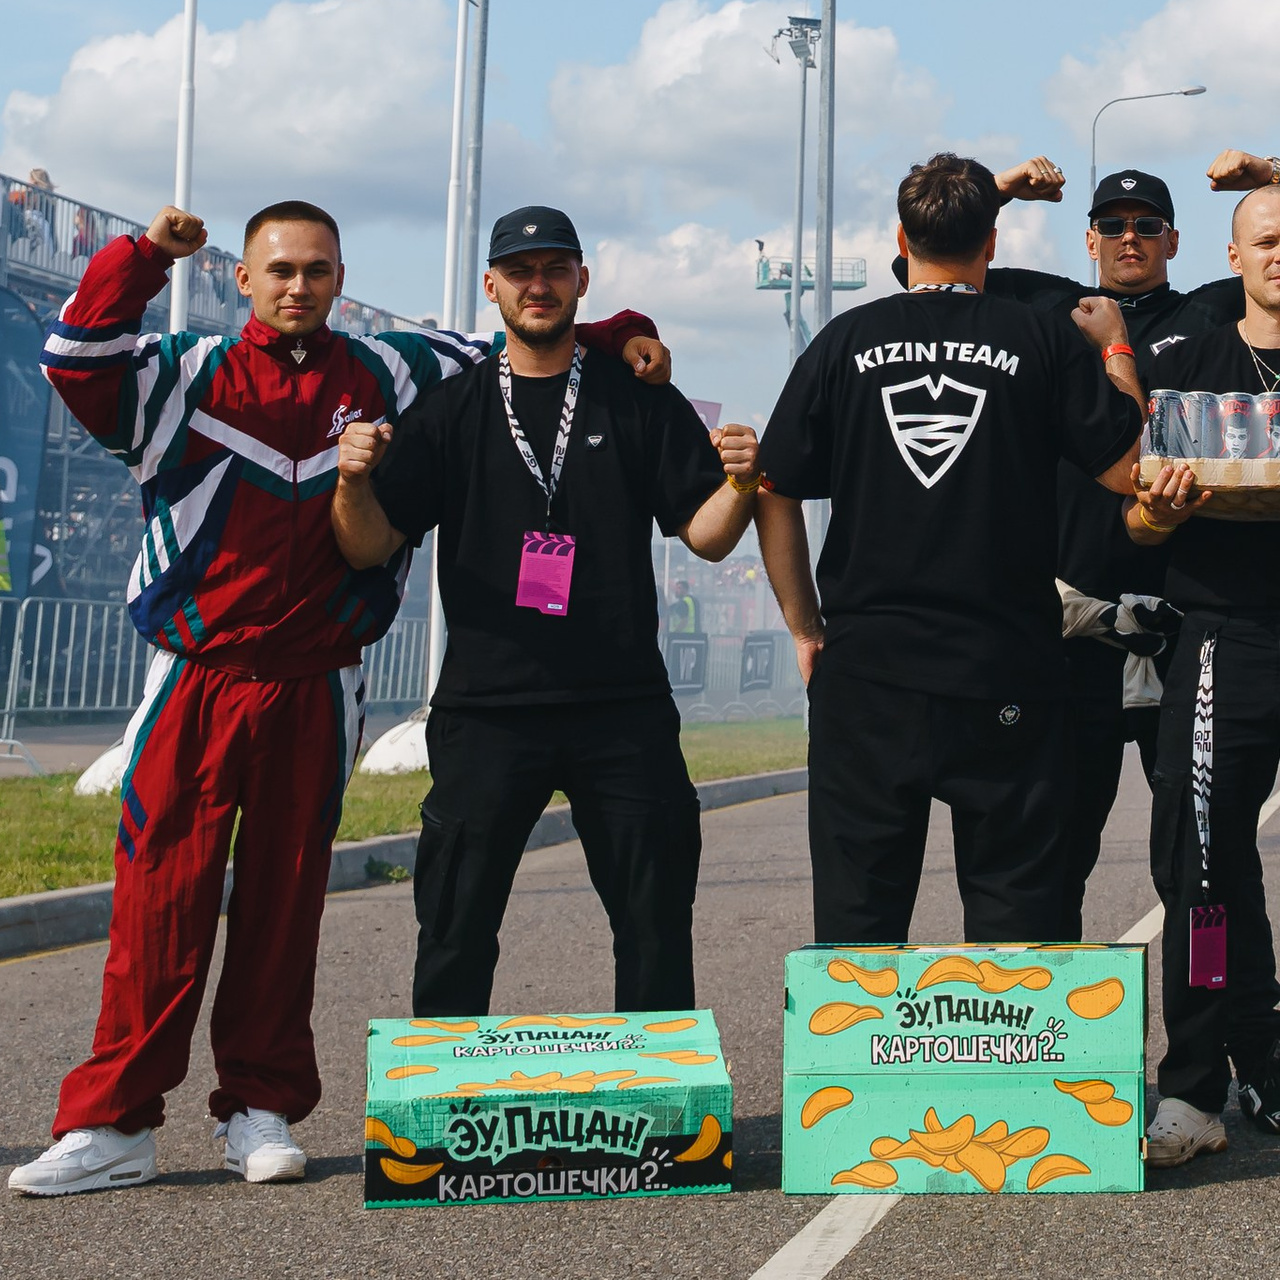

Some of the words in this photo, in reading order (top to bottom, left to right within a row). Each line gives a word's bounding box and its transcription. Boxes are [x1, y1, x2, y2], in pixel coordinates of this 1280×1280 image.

[854, 341, 937, 374] KIZIN
[943, 341, 1020, 376] TEAM
[933, 994, 1035, 1031] ПАЦАН!
[514, 1030, 613, 1042] ПАЦАН!
[504, 1106, 650, 1152] ПАЦАН!
